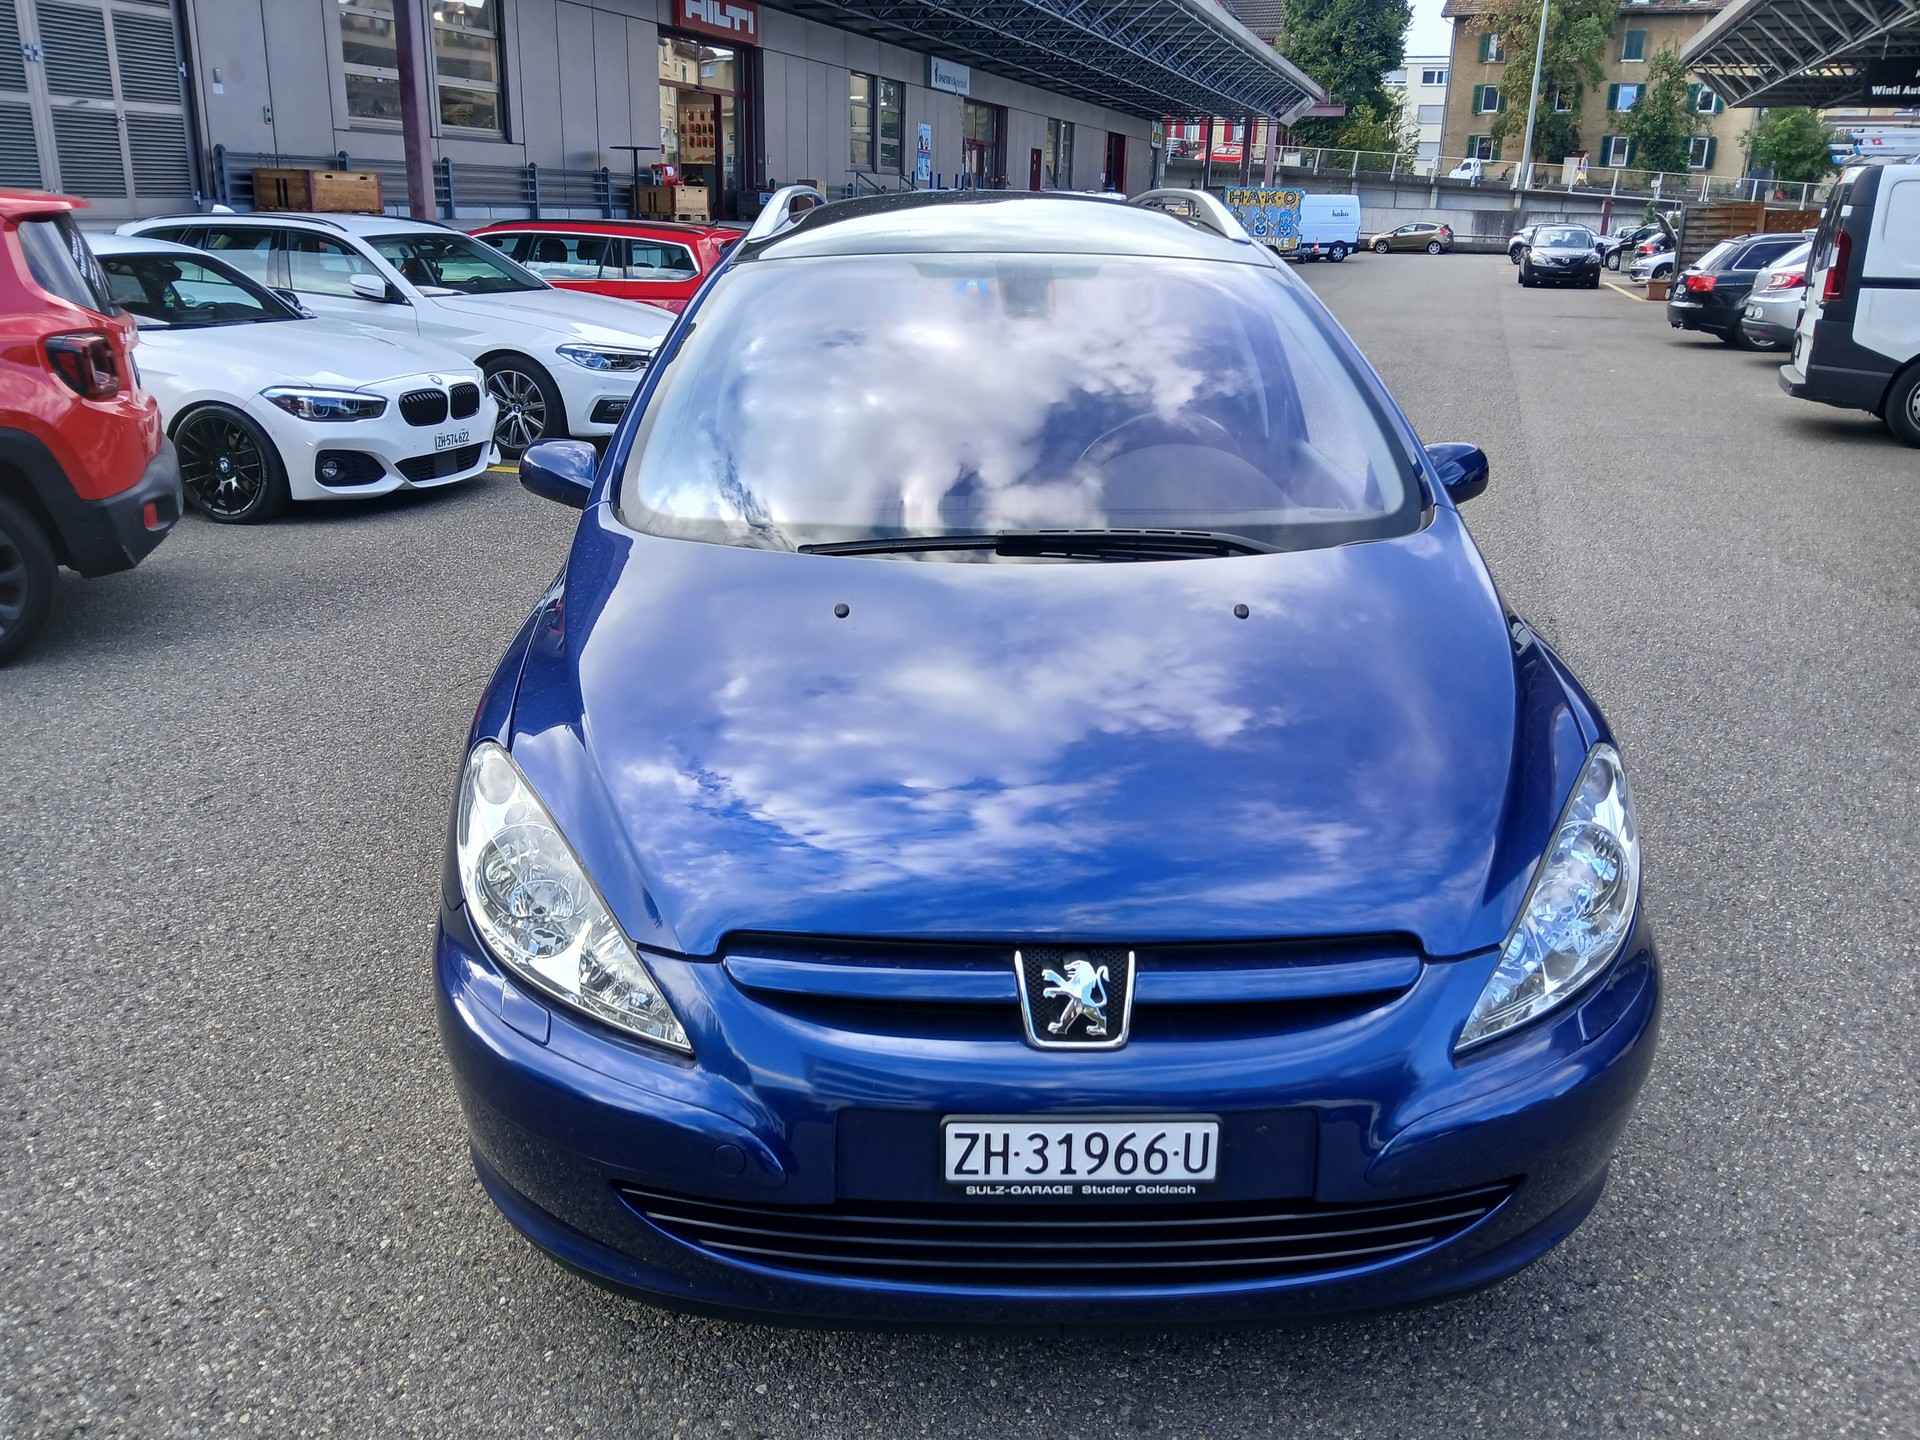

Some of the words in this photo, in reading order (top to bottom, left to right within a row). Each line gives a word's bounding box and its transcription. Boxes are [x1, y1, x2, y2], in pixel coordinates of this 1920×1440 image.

[685, 0, 754, 34] HILTI
[1871, 85, 1900, 95] Winti
[966, 1185, 1073, 1195] SULZ-GARAGE
[1081, 1184, 1131, 1194] Studer
[1135, 1184, 1196, 1194] Goldach
